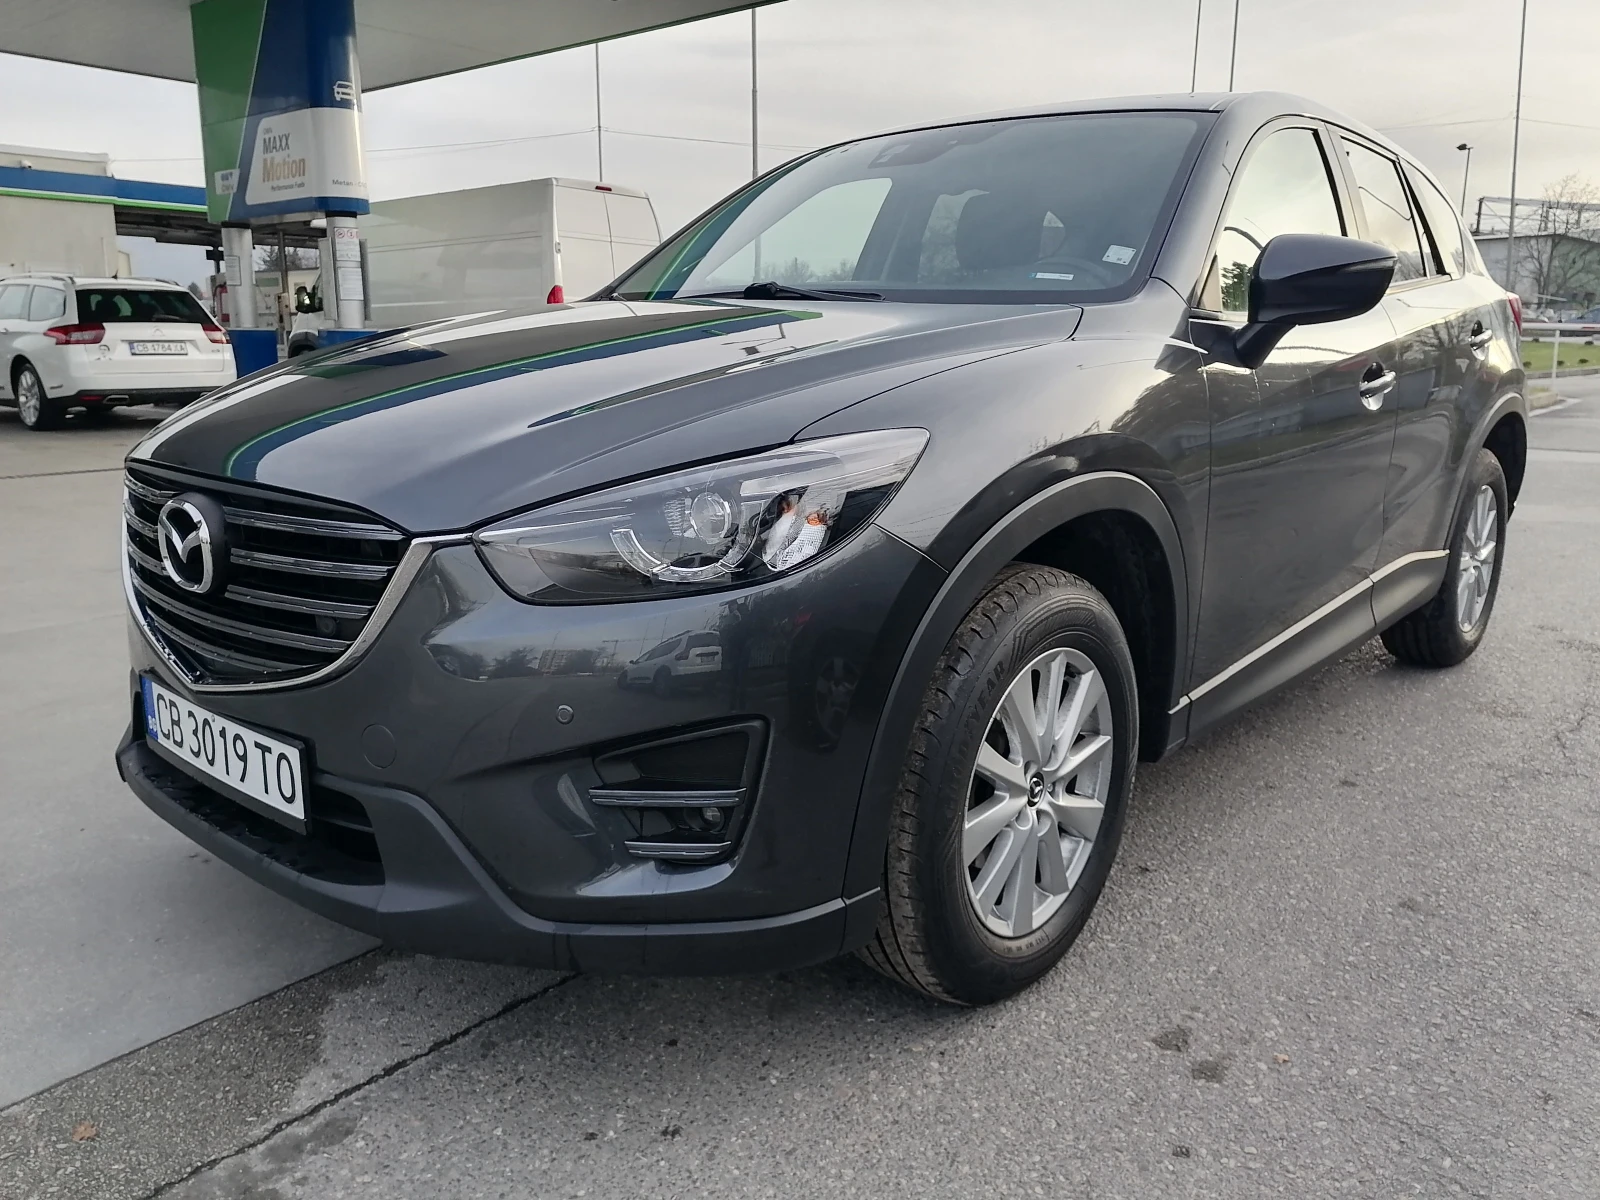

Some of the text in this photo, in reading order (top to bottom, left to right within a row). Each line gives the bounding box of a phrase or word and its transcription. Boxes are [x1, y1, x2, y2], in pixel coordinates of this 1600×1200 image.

[263, 132, 290, 155] MAXX
[262, 153, 306, 183] Motion
[156, 692, 184, 749] CB
[187, 709, 248, 784] 3019
